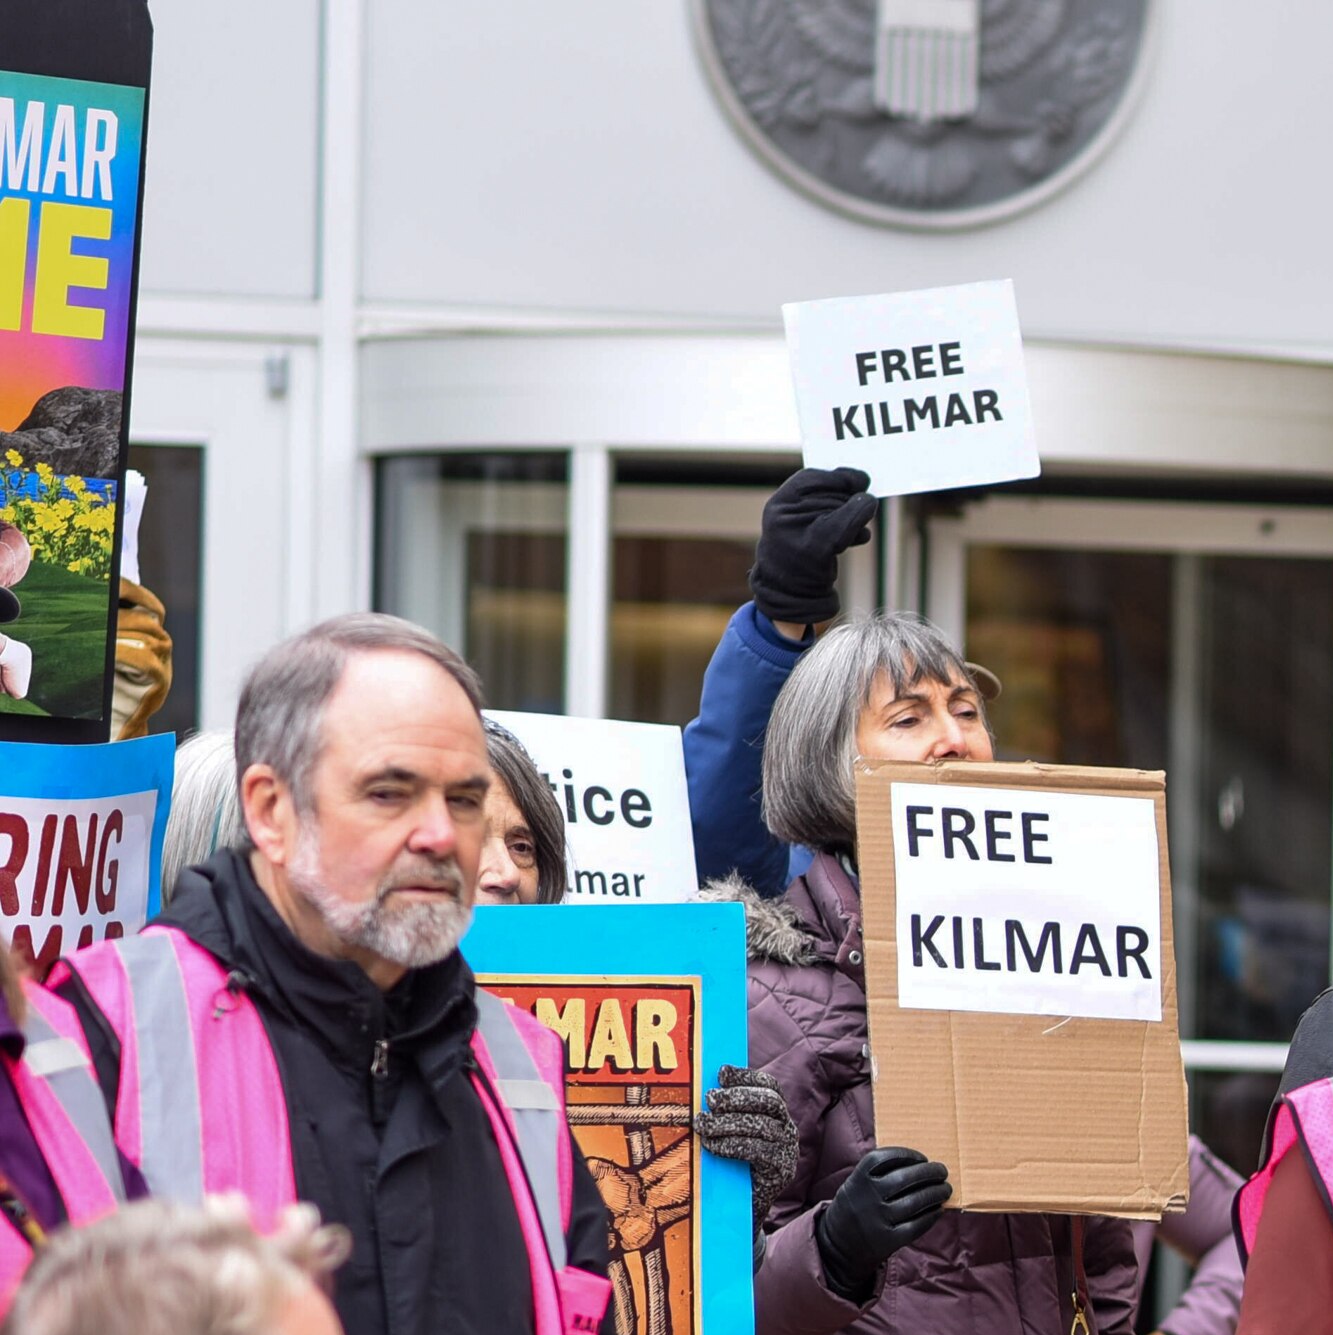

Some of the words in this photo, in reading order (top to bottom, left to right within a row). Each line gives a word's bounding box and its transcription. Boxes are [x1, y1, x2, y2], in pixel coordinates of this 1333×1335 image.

[855, 341, 965, 386] FREE
[832, 389, 1004, 441] KILMAR
[906, 805, 1053, 864] FREE
[566, 869, 646, 898] mar
[911, 914, 1153, 979] KILMAR
[499, 997, 679, 1070] MAR
